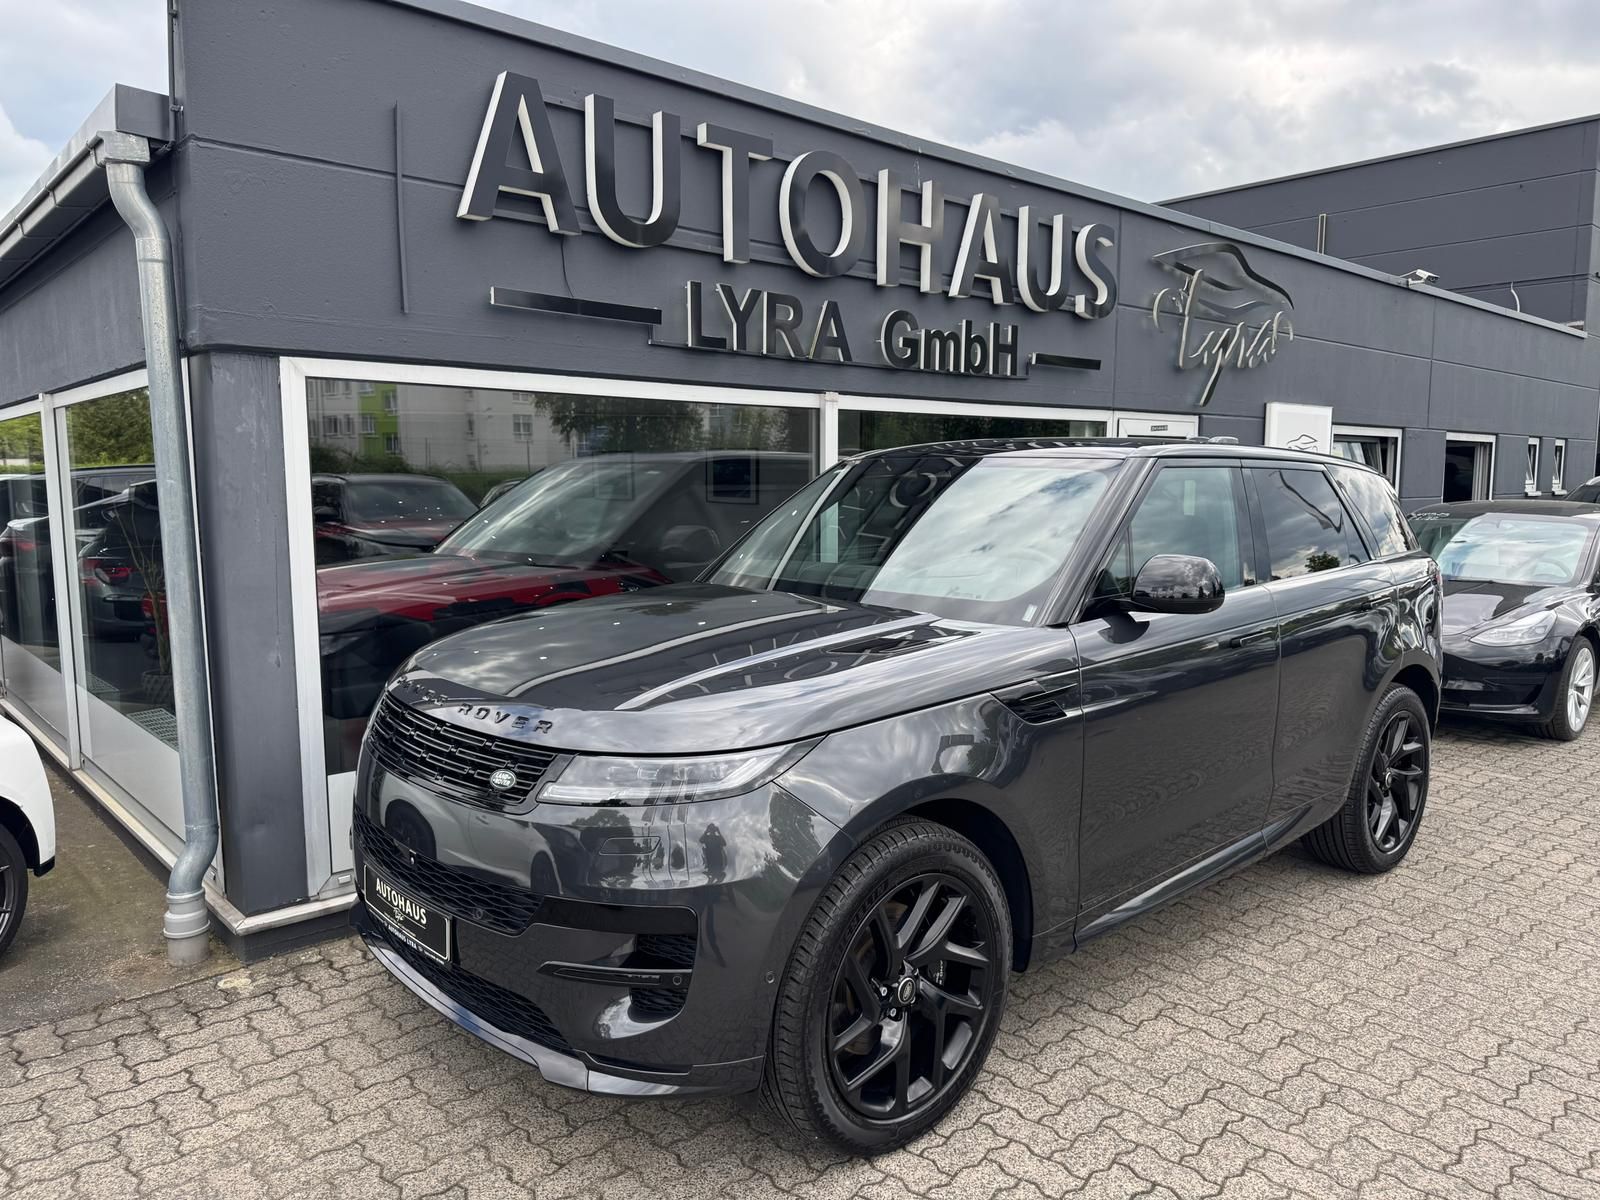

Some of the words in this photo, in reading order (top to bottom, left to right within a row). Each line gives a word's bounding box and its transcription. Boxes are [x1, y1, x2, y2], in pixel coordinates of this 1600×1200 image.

[456, 70, 1118, 319] AUTOHAUS
[685, 280, 853, 362] LYRA
[878, 309, 1019, 376] GmbH
[457, 703, 553, 734] ROVER
[376, 877, 427, 925] AUTOHAUS
